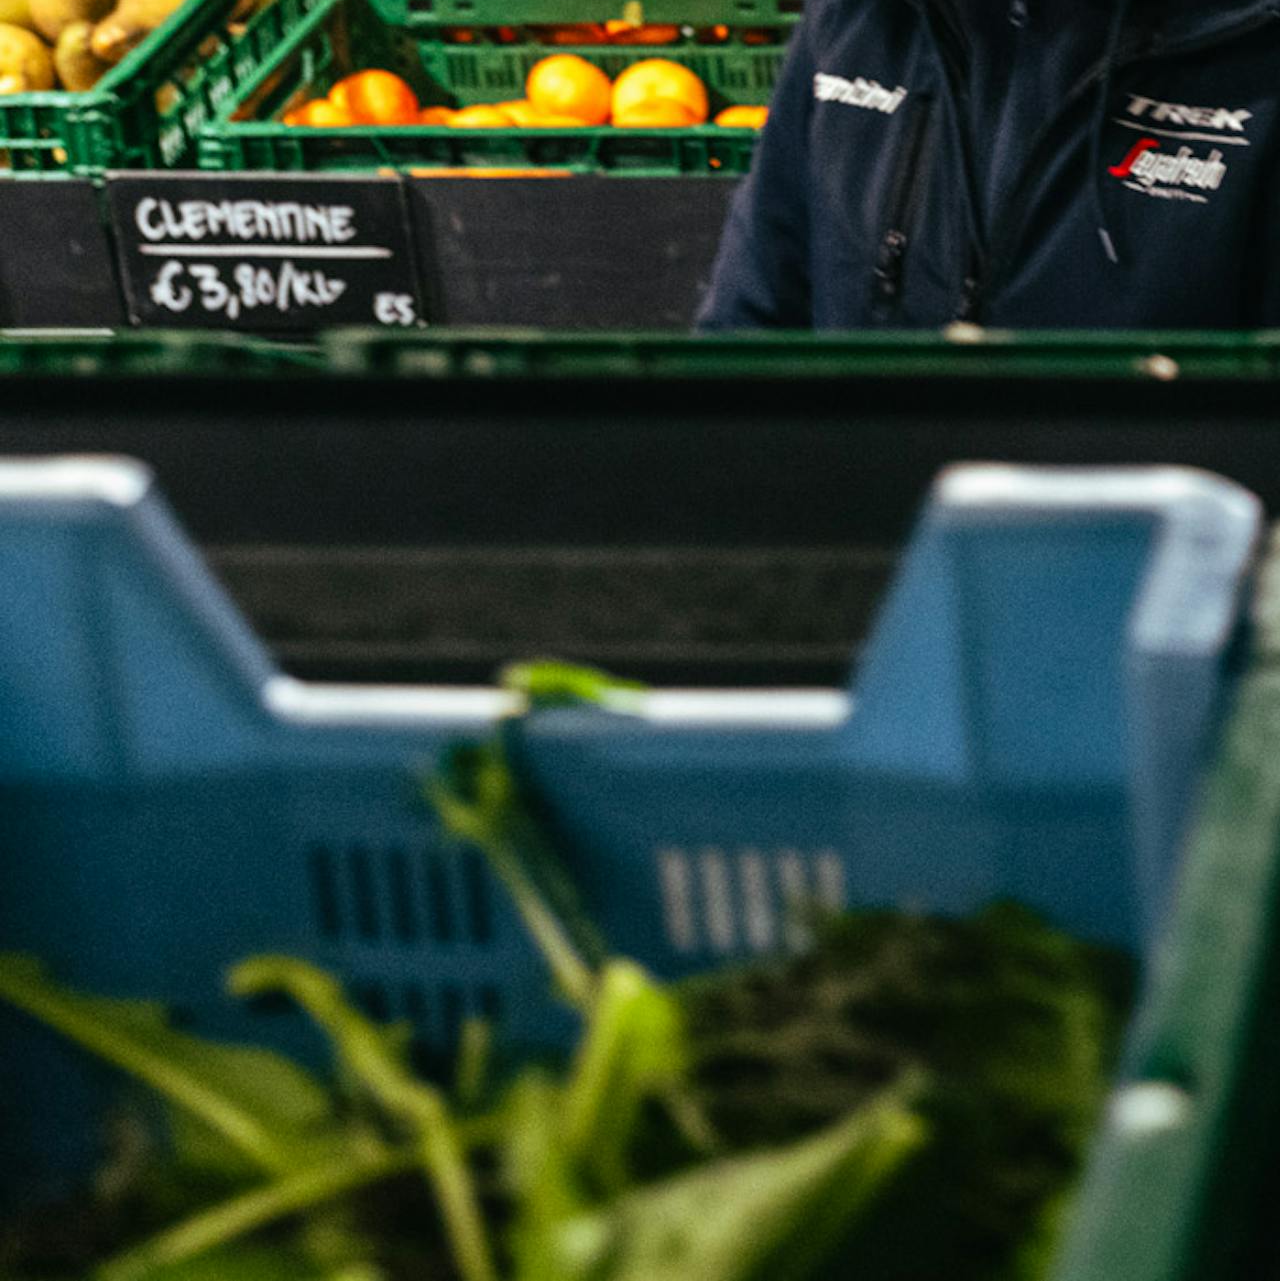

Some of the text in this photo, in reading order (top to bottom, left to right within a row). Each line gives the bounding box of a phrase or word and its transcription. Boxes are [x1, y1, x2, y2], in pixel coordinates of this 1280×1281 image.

[1127, 94, 1252, 131] TREK
[135, 197, 357, 244] CLEMENTINE
[373, 291, 416, 325] ES
